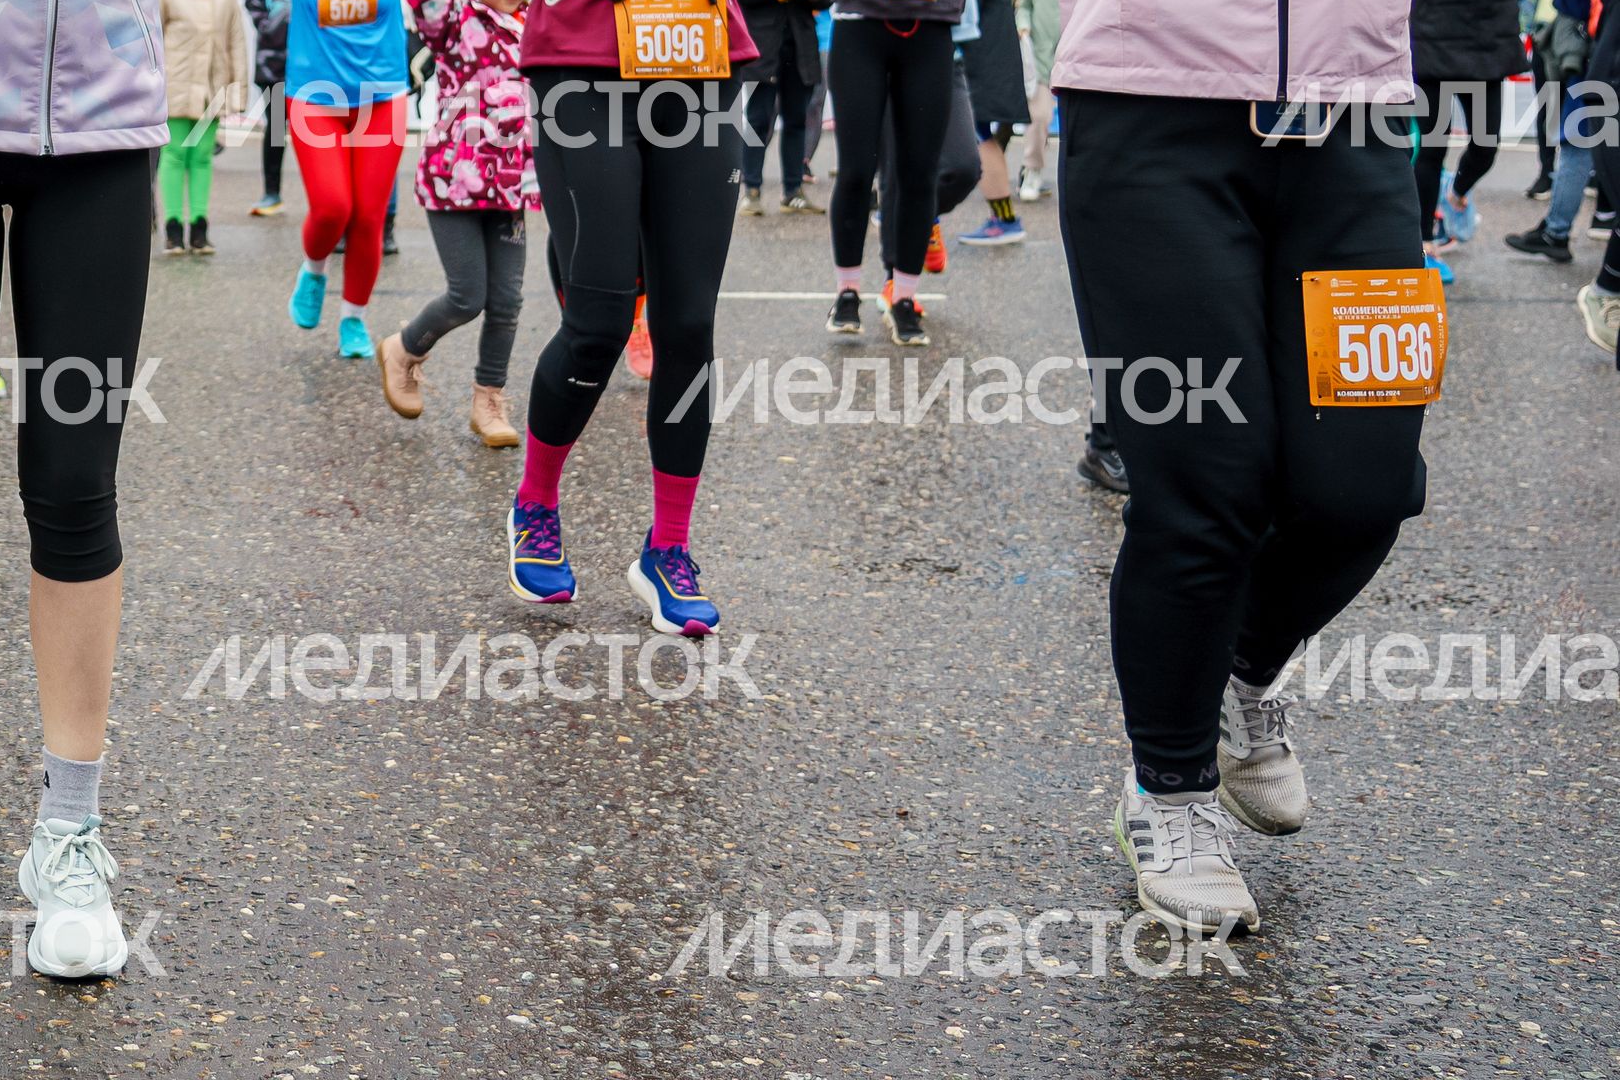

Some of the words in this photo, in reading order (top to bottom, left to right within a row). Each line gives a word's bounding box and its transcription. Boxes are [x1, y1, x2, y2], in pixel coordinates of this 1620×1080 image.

[635, 24, 704, 63] 5096
[1338, 322, 1433, 382] 5036
[1135, 757, 1183, 786] RO
